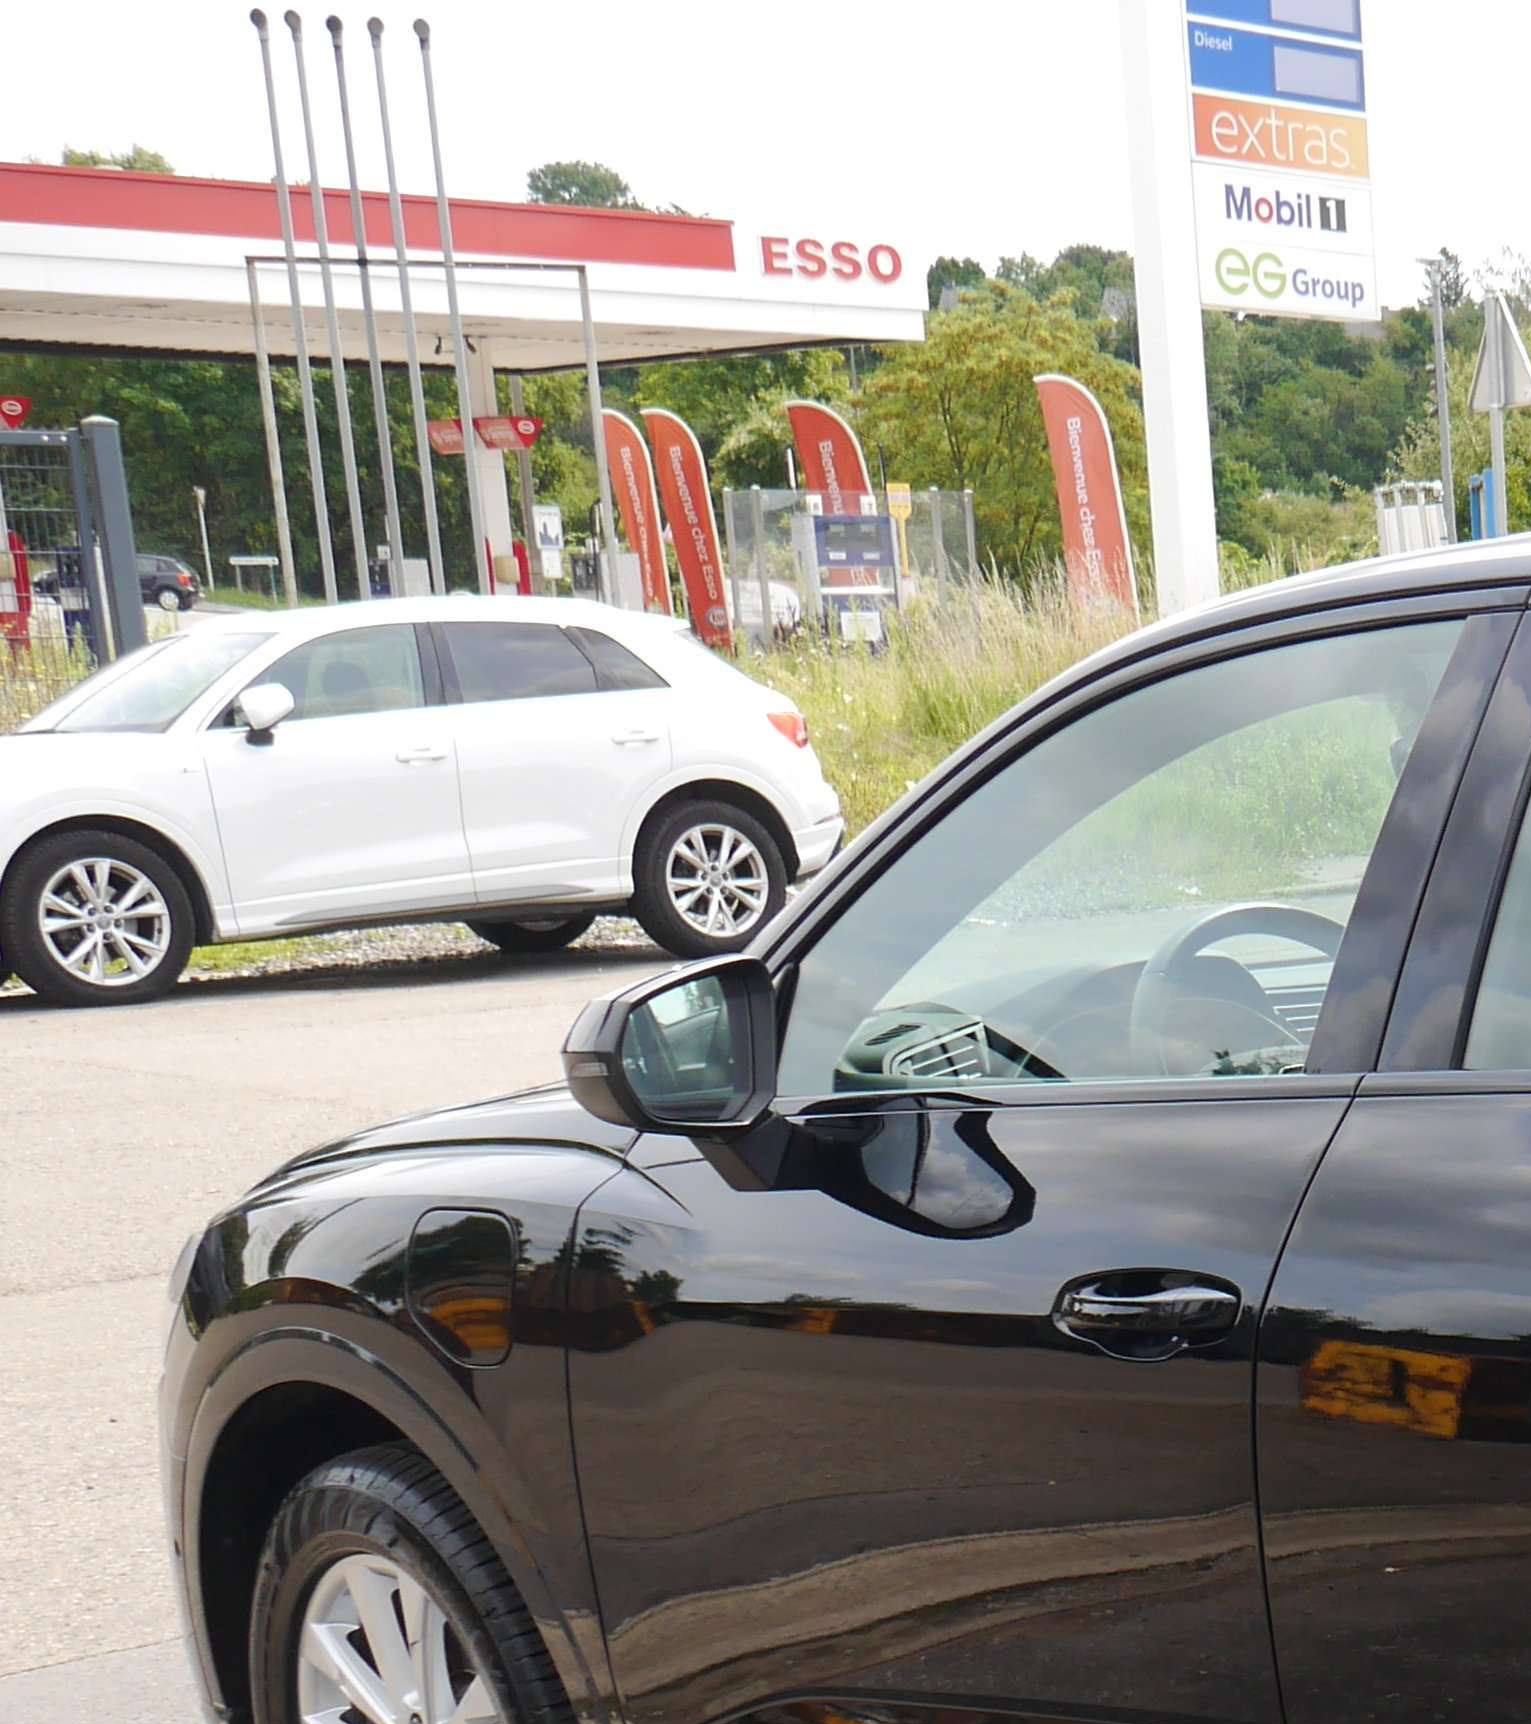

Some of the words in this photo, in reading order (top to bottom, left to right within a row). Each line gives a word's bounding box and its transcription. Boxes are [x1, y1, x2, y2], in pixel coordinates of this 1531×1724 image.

[1194, 31, 1233, 52] Diesel
[1224, 184, 1312, 229] Mobil
[1322, 197, 1343, 231] 1
[760, 236, 902, 284] ESSO
[1291, 268, 1365, 308] Group
[620, 446, 645, 524] Bienvenue
[1066, 416, 1090, 504] Bienvenue
[1079, 506, 1096, 548] chez
[669, 445, 698, 525] Bienvenue
[690, 526, 709, 562] chez
[701, 564, 718, 600] Esso
